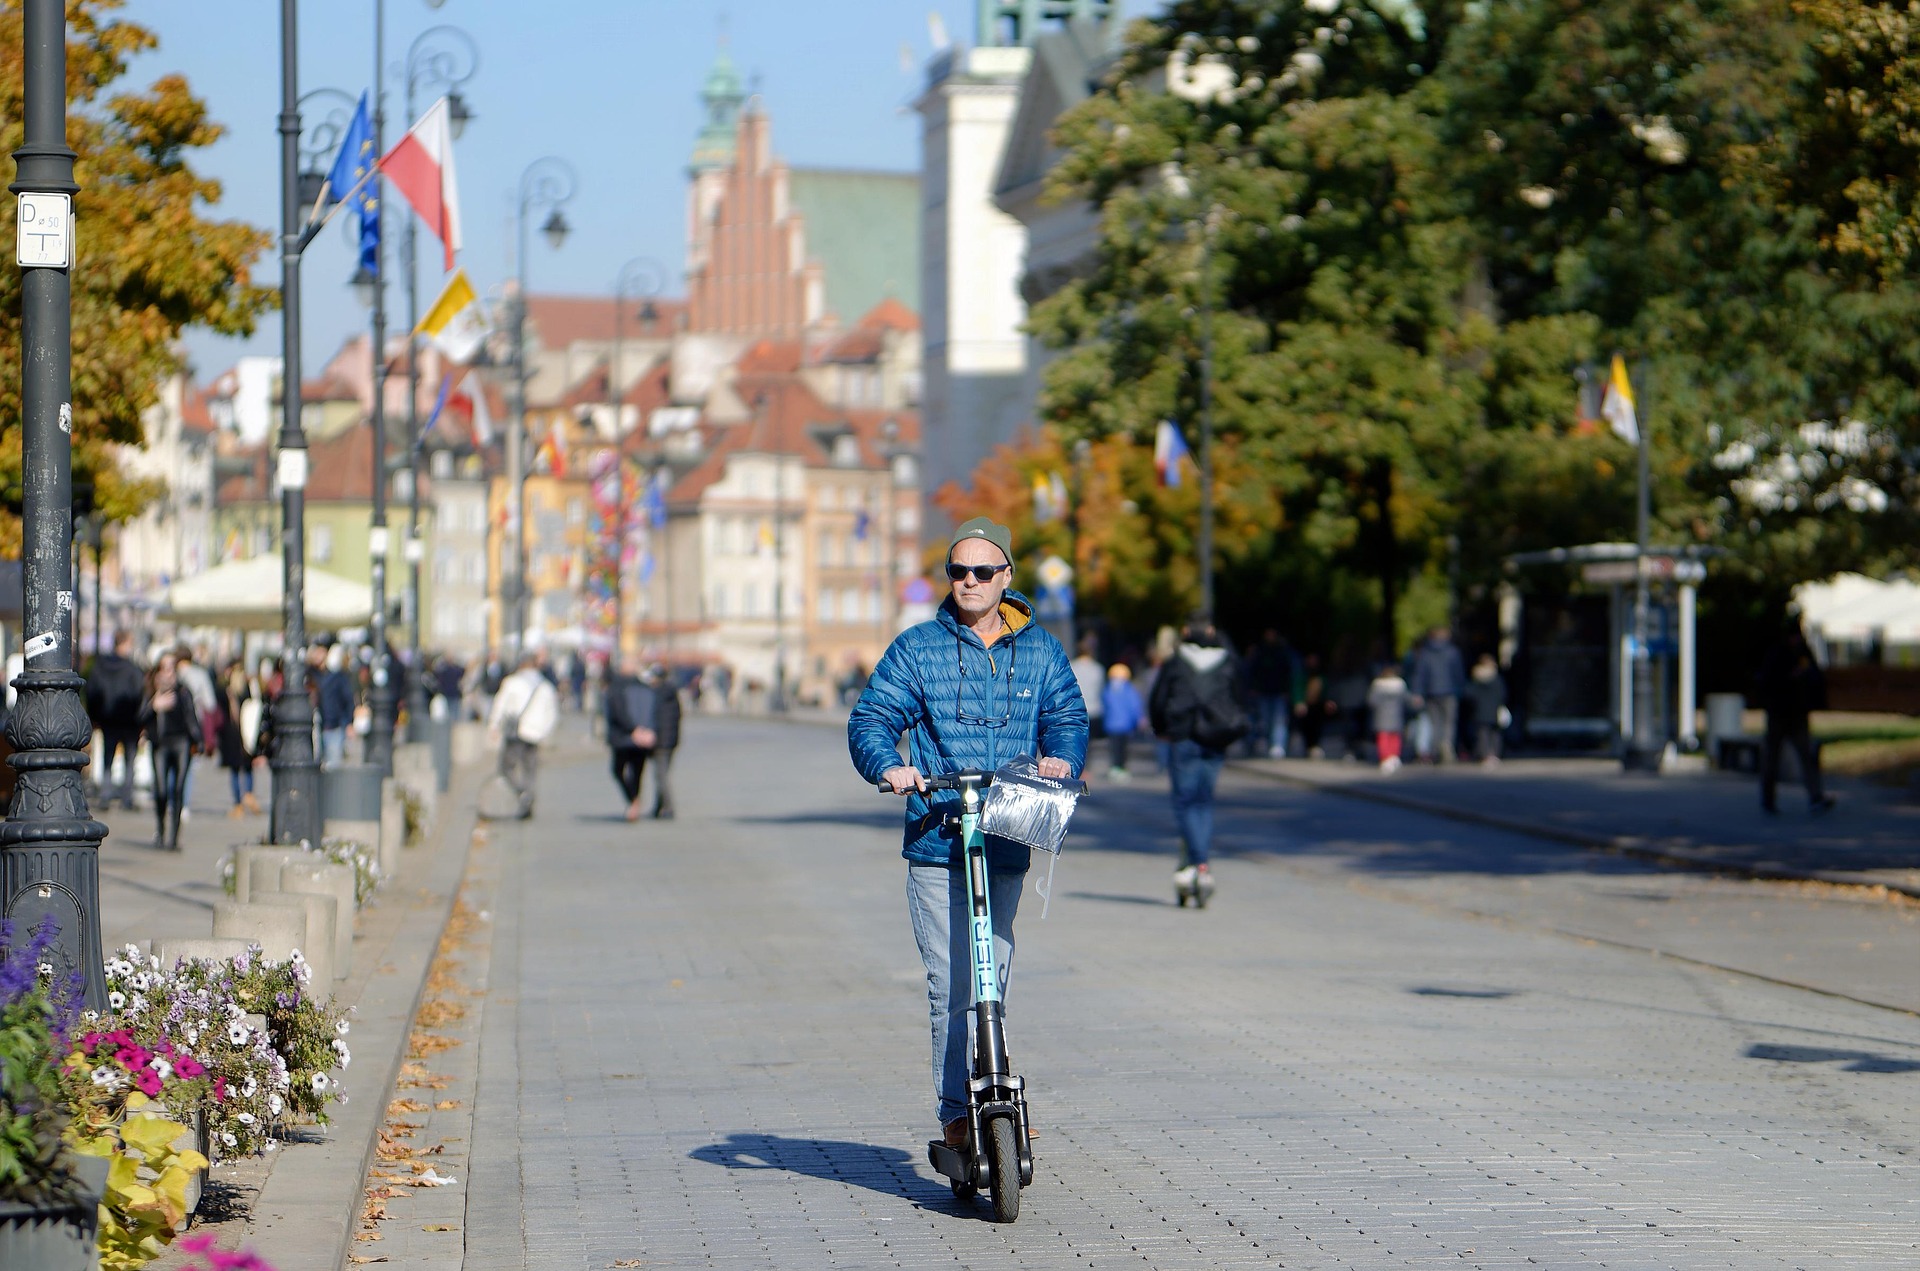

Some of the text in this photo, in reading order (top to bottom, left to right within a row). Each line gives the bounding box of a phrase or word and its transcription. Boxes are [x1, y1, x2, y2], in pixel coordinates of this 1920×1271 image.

[22, 203, 36, 223] D
[47, 216, 59, 228] 50
[974, 921, 993, 996] TIER
